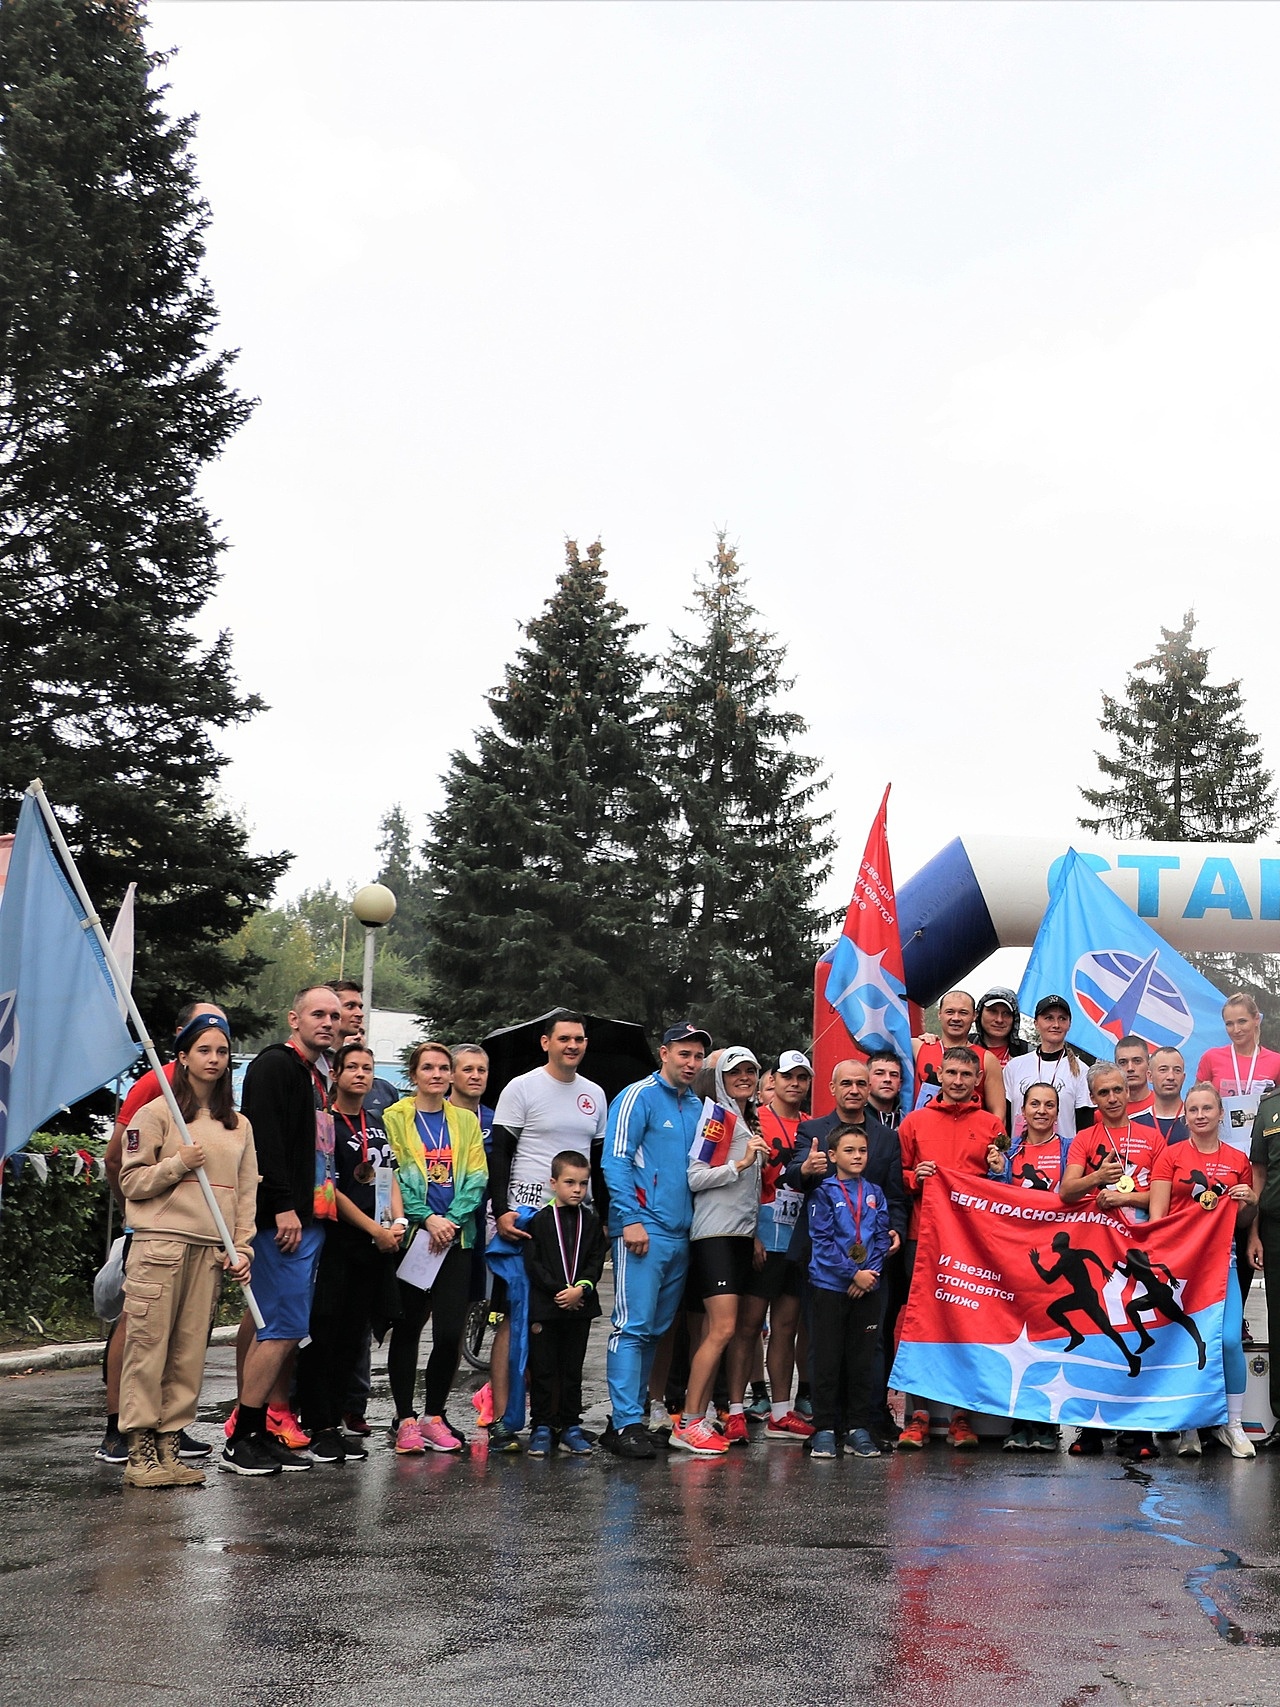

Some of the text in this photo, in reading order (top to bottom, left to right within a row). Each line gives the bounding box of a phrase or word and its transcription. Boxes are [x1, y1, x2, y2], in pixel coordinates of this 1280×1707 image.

[856, 875, 895, 925] ановятся
[950, 1191, 988, 1211] БЕГИ
[938, 1253, 1001, 1282] И звезды
[934, 1288, 980, 1310] ближе
[936, 1272, 1015, 1302] становятся
